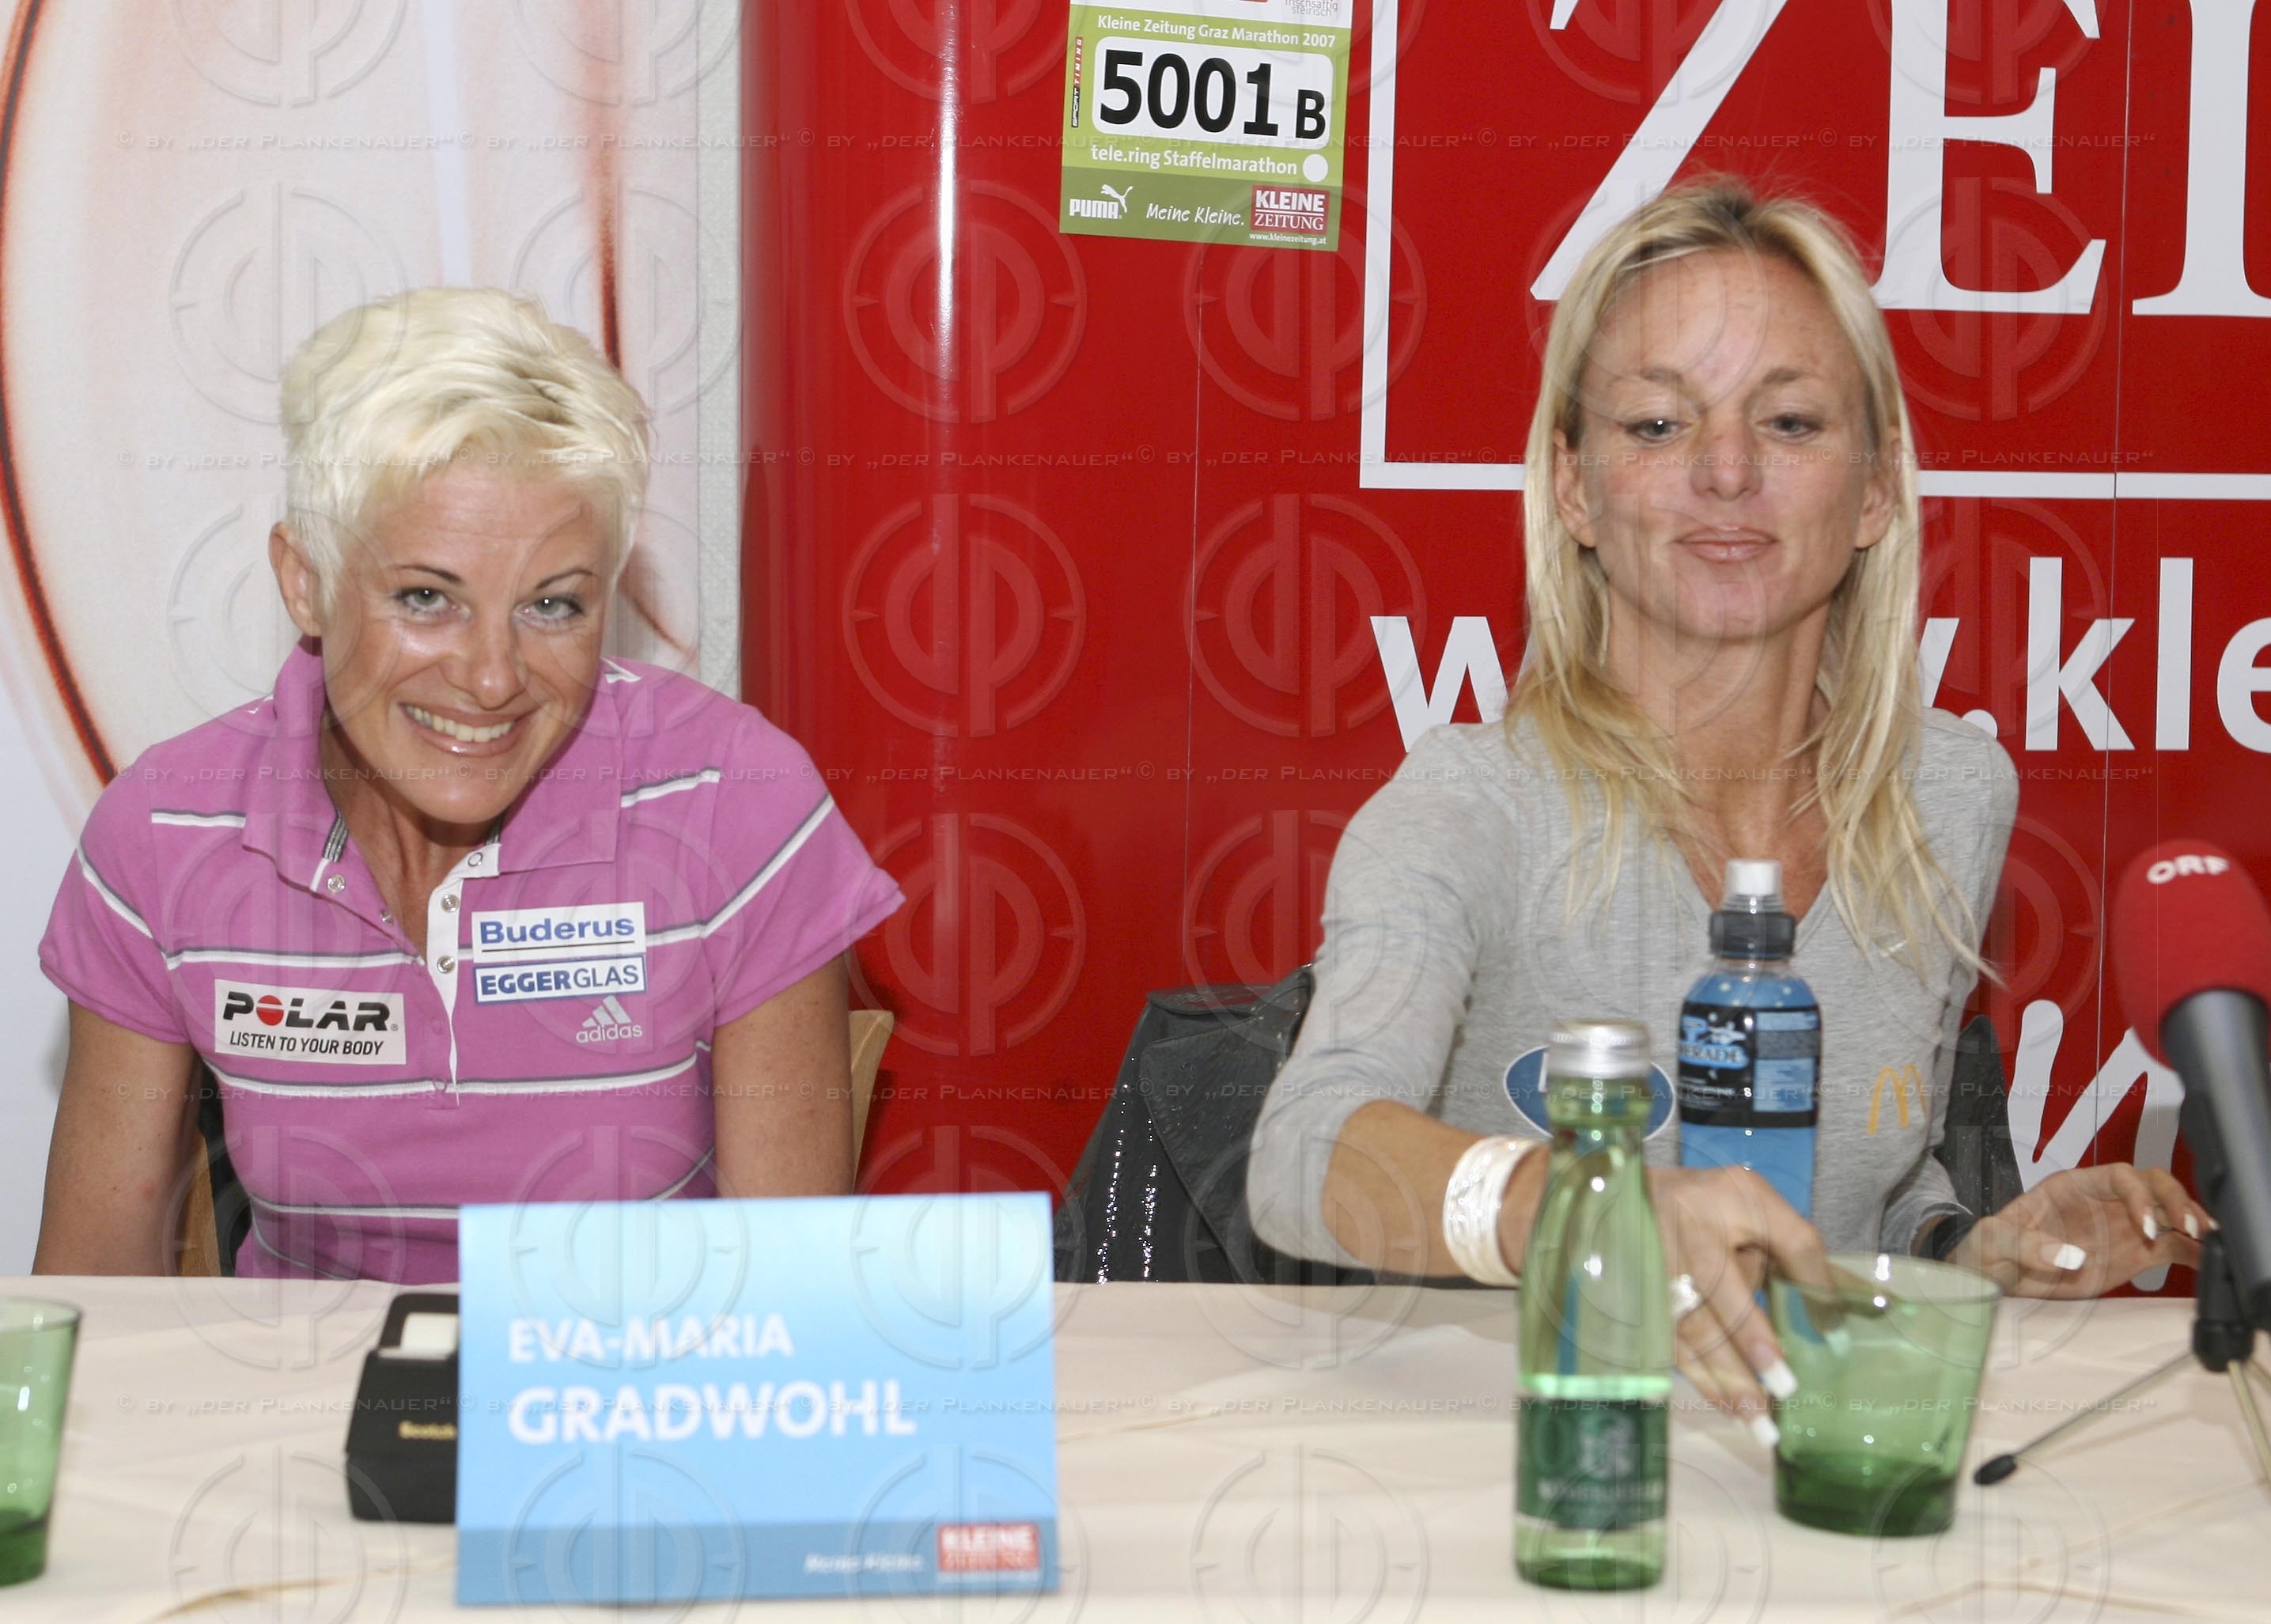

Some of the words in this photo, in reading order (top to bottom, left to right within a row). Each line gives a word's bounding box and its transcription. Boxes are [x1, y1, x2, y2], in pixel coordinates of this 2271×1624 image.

[1098, 15, 1141, 32] Kleine
[1144, 19, 1195, 39] Zeitung
[1198, 24, 1228, 39] Graz
[1232, 28, 1299, 45] Marathon
[1303, 32, 1336, 48] 2007
[1100, 48, 1278, 137] 5001
[1295, 89, 1327, 140] B
[1091, 145, 1160, 169] tele.ring
[1164, 150, 1297, 175] Staffelmarathon
[1069, 199, 1119, 220] PUMA
[1146, 203, 1190, 221] Meine
[1194, 206, 1244, 225] Kleine.
[1255, 190, 1326, 212] KLEINE
[1254, 214, 1324, 230] ZEITUNG
[1249, 233, 1327, 246] www.kleinezeitung.at
[2146, 854, 2229, 884] ORF
[480, 914, 635, 944] Buderus
[481, 964, 640, 995] EGGERGLAS
[222, 991, 392, 1032] POLAR
[229, 1031, 274, 1050] LISTEN
[279, 1036, 297, 1051] TO
[299, 1037, 339, 1054] YOUR
[343, 1040, 384, 1056] BODY
[576, 1020, 643, 1044] adidas
[508, 1311, 795, 1363] EVA-MARIA
[507, 1378, 918, 1445] GRADWOHL
